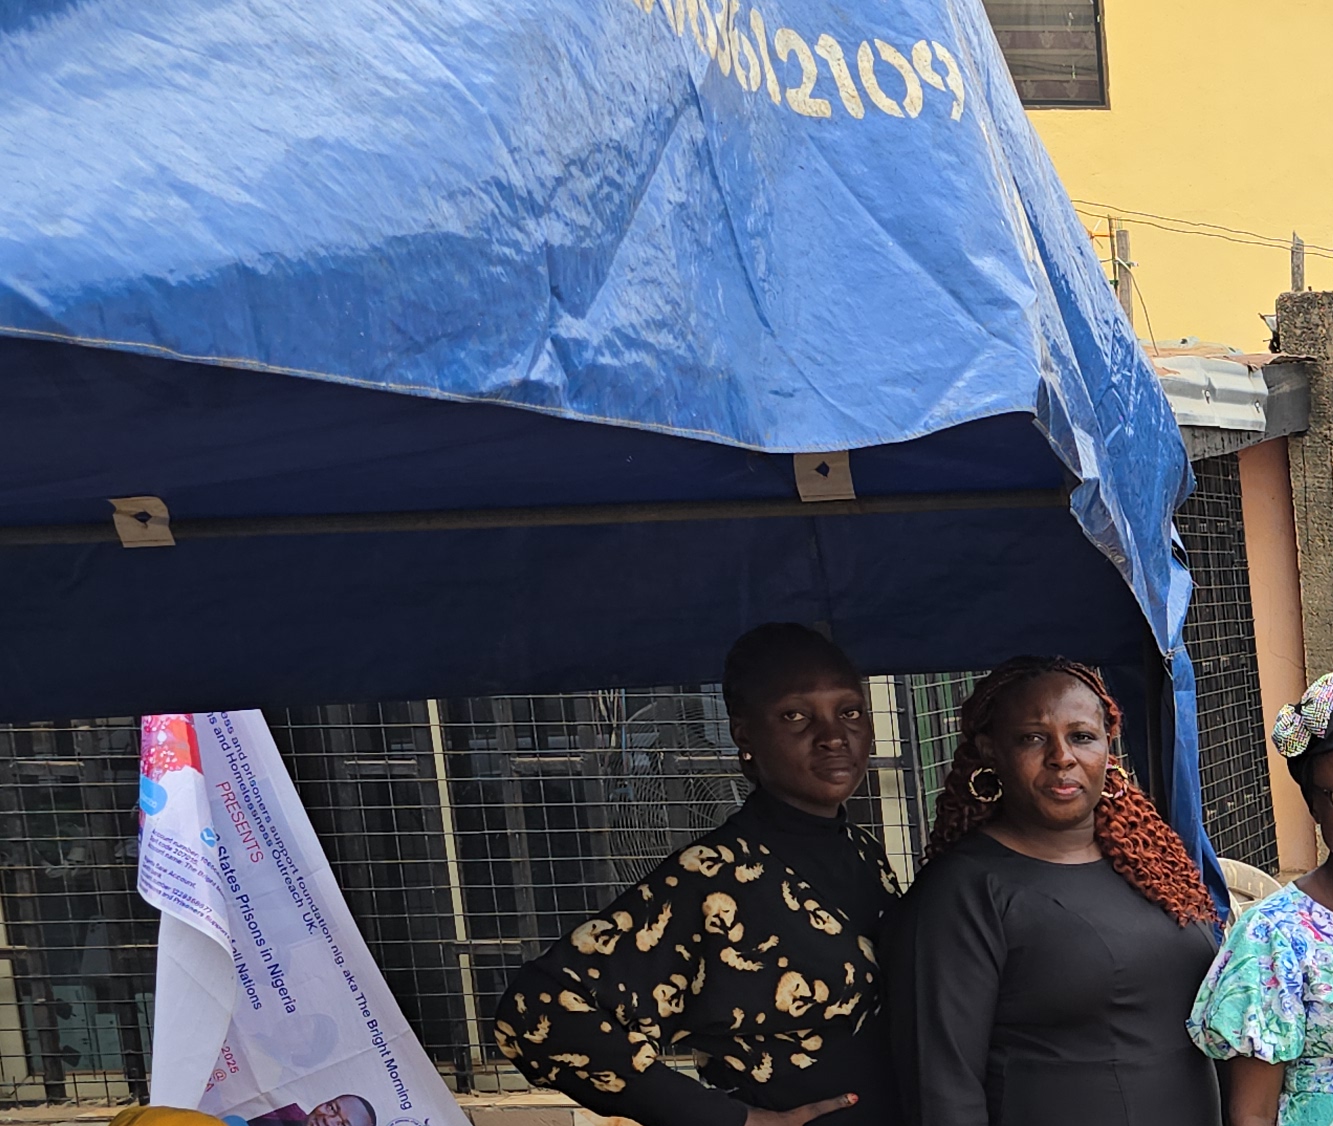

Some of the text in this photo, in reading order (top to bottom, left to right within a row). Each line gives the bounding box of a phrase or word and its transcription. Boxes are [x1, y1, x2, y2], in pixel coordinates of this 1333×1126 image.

[213, 727, 232, 752] and
[272, 848, 304, 908] Outreach
[302, 911, 318, 935] UK.
[215, 781, 264, 864] PRESENTS
[232, 737, 247, 761] and
[241, 762, 272, 824] prisoners
[270, 825, 299, 875] support
[296, 876, 333, 944] foundation
[343, 969, 358, 993] aka
[355, 992, 371, 1018] The
[367, 1018, 392, 1058] Bright
[384, 1058, 413, 1111] Morning
[236, 894, 267, 947] Prisons
[260, 947, 274, 962] in
[267, 963, 297, 1014] Nigeria
[236, 963, 263, 1011] Nations
[221, 1046, 240, 1074] 2025
